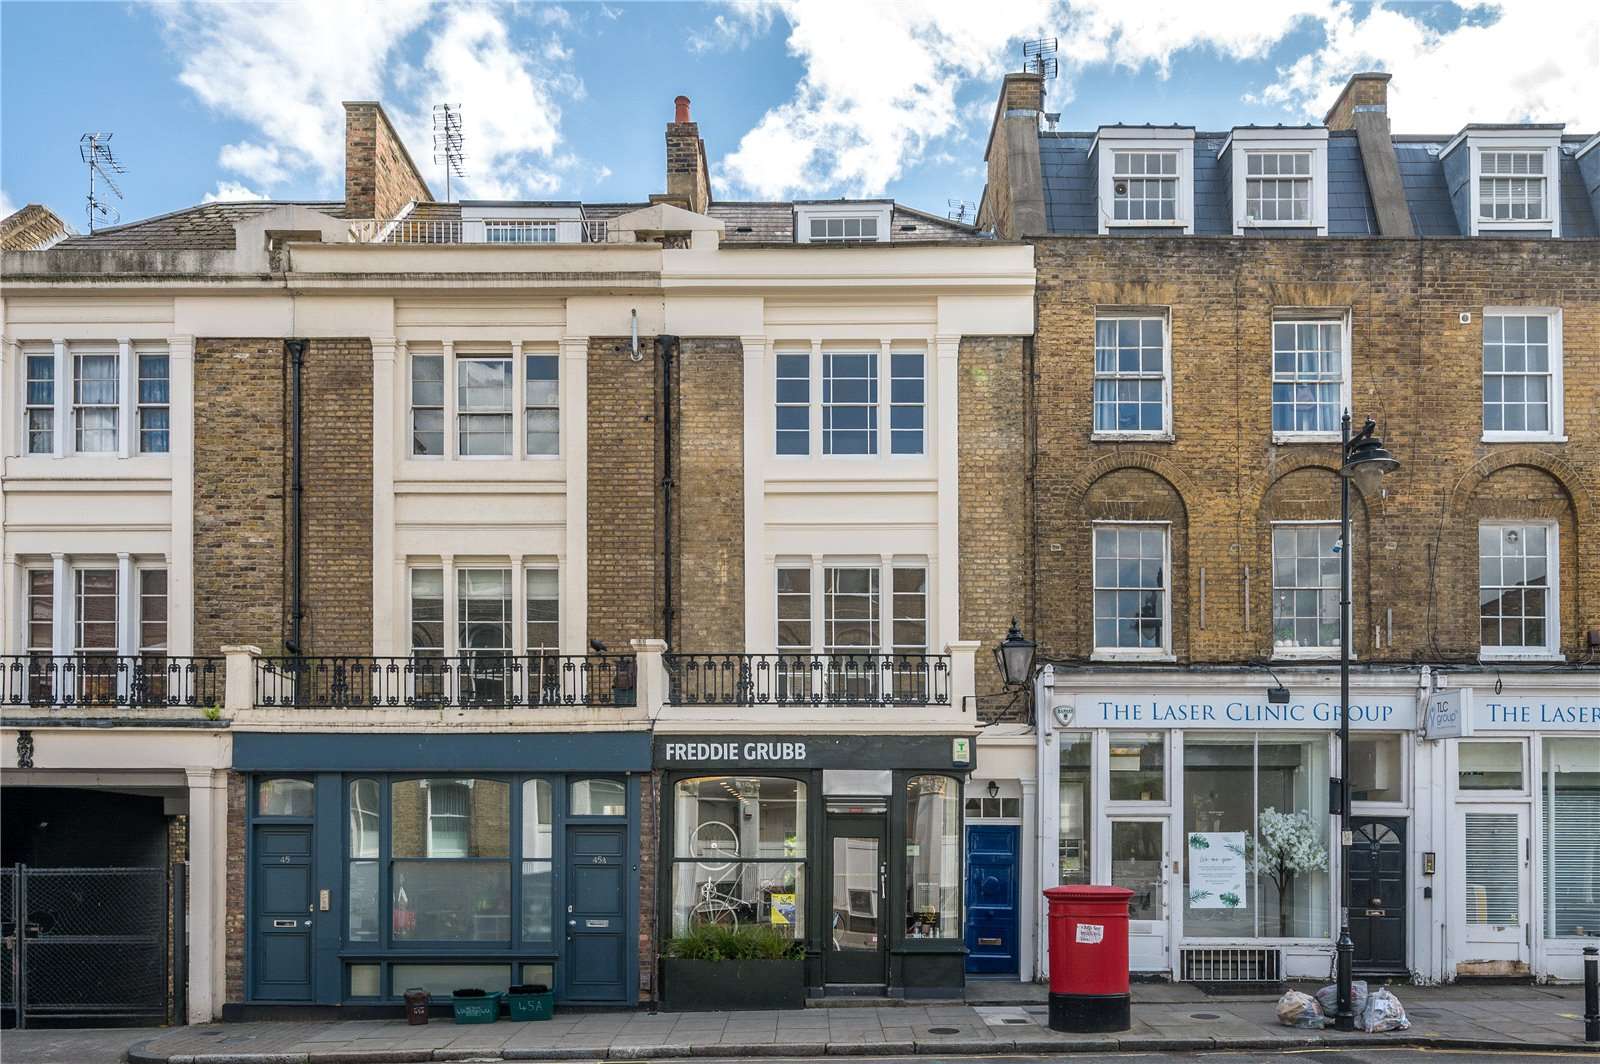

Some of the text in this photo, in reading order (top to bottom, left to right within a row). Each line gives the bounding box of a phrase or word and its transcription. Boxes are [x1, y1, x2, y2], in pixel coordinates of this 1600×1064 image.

[1098, 702, 1142, 720] THE
[1152, 702, 1216, 721] LASER
[1226, 702, 1305, 721] CLINIC
[1437, 701, 1449, 713] TLC
[1486, 703, 1530, 722] THE
[666, 742, 807, 761] FREDDIE GRUBB
